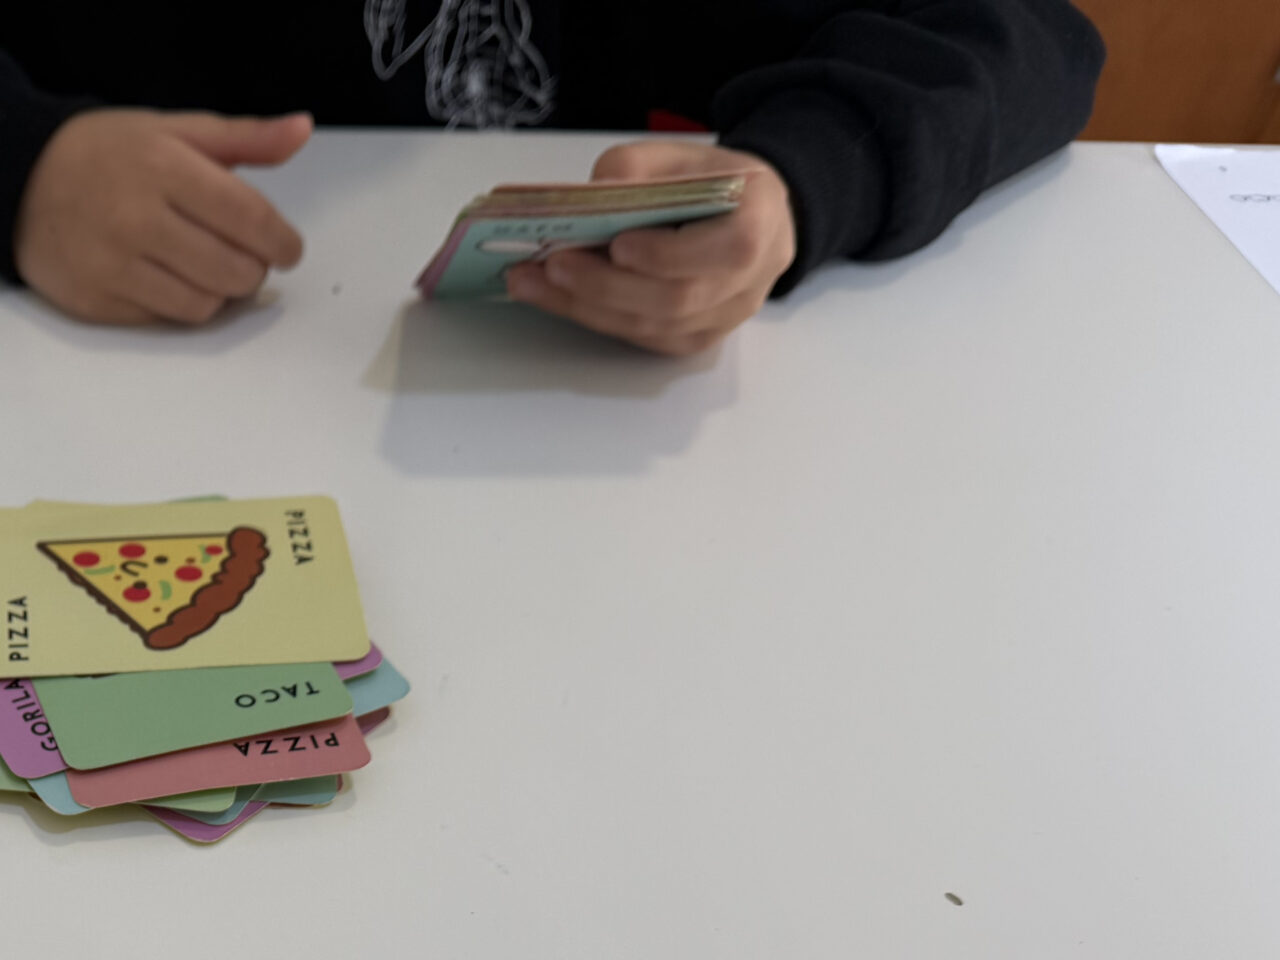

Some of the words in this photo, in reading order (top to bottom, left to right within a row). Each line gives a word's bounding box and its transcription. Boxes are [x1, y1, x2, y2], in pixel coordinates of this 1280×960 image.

[284, 508, 314, 566] PIZZA
[7, 596, 30, 662] PIZZA
[4, 678, 59, 752] GORILA
[233, 681, 319, 709] TACO
[232, 731, 340, 757] PIZZA
